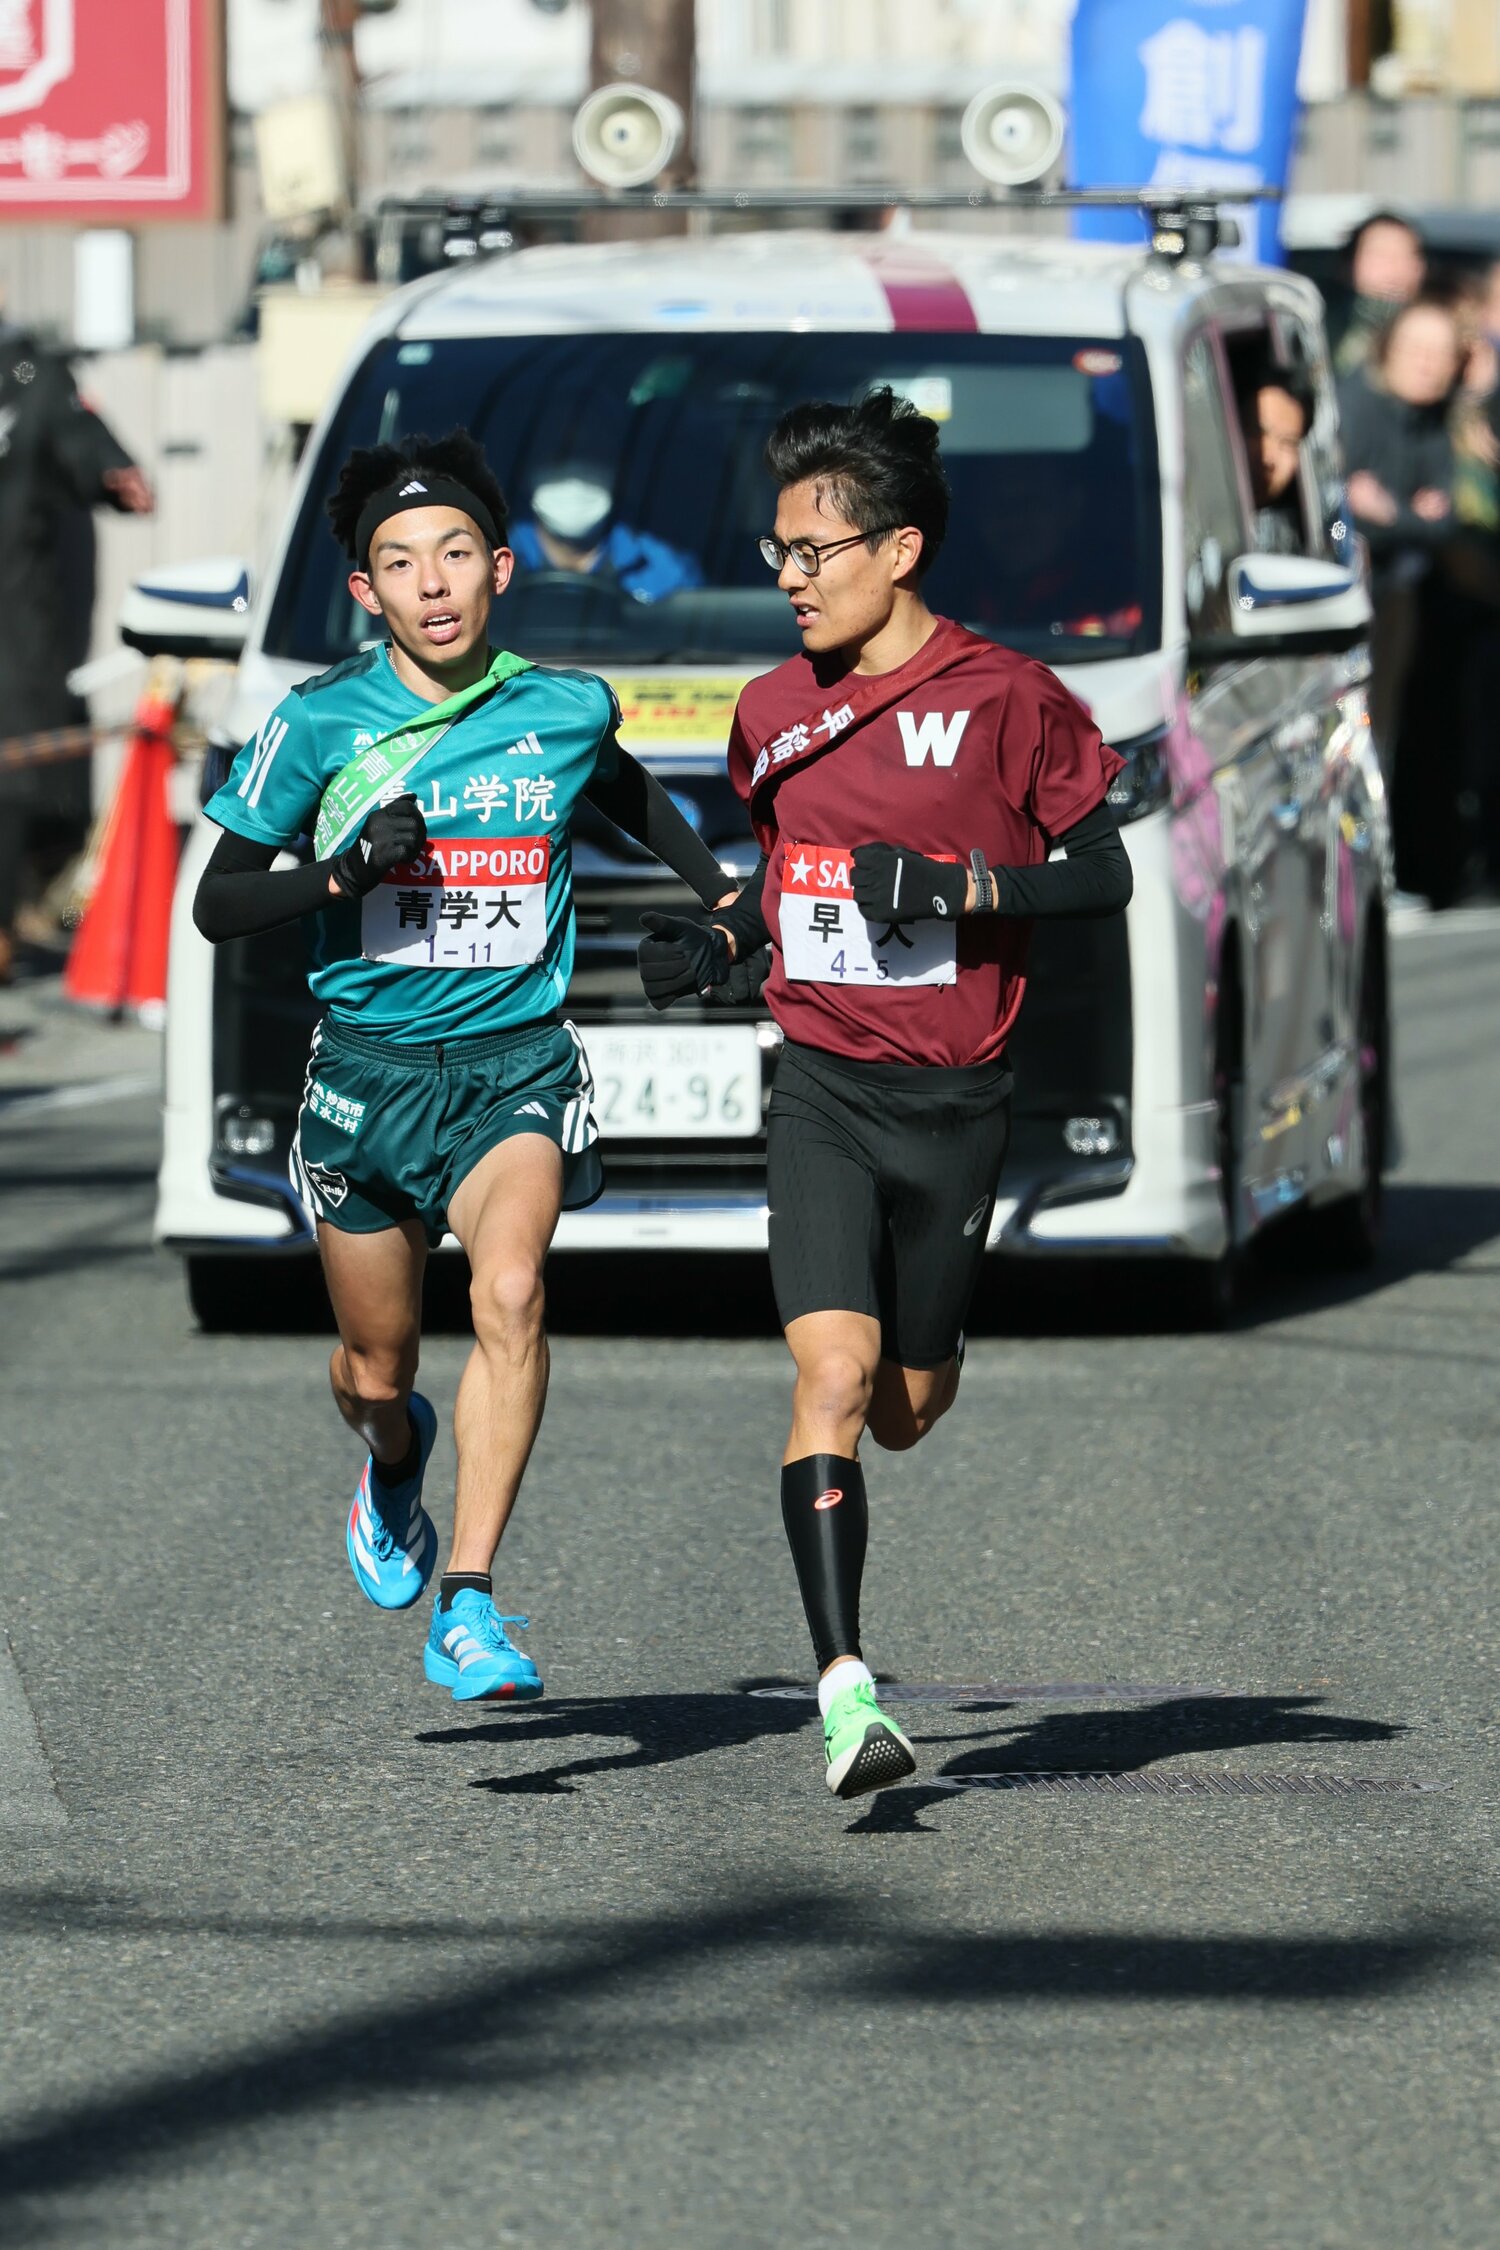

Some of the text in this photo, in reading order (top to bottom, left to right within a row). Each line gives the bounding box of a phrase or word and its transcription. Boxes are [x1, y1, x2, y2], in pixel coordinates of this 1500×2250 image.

[751, 703, 856, 787] 早稲田
[896, 710, 970, 767] W
[409, 847, 546, 878] SAPPORO
[816, 859, 856, 890] SA
[394, 889, 522, 930] 青学大
[424, 934, 492, 964] 1-11
[830, 949, 889, 980] 4-5
[325, 1089, 366, 1118] 妙高市
[600, 1073, 744, 1124] 24-96
[319, 1105, 359, 1134] 水上村
